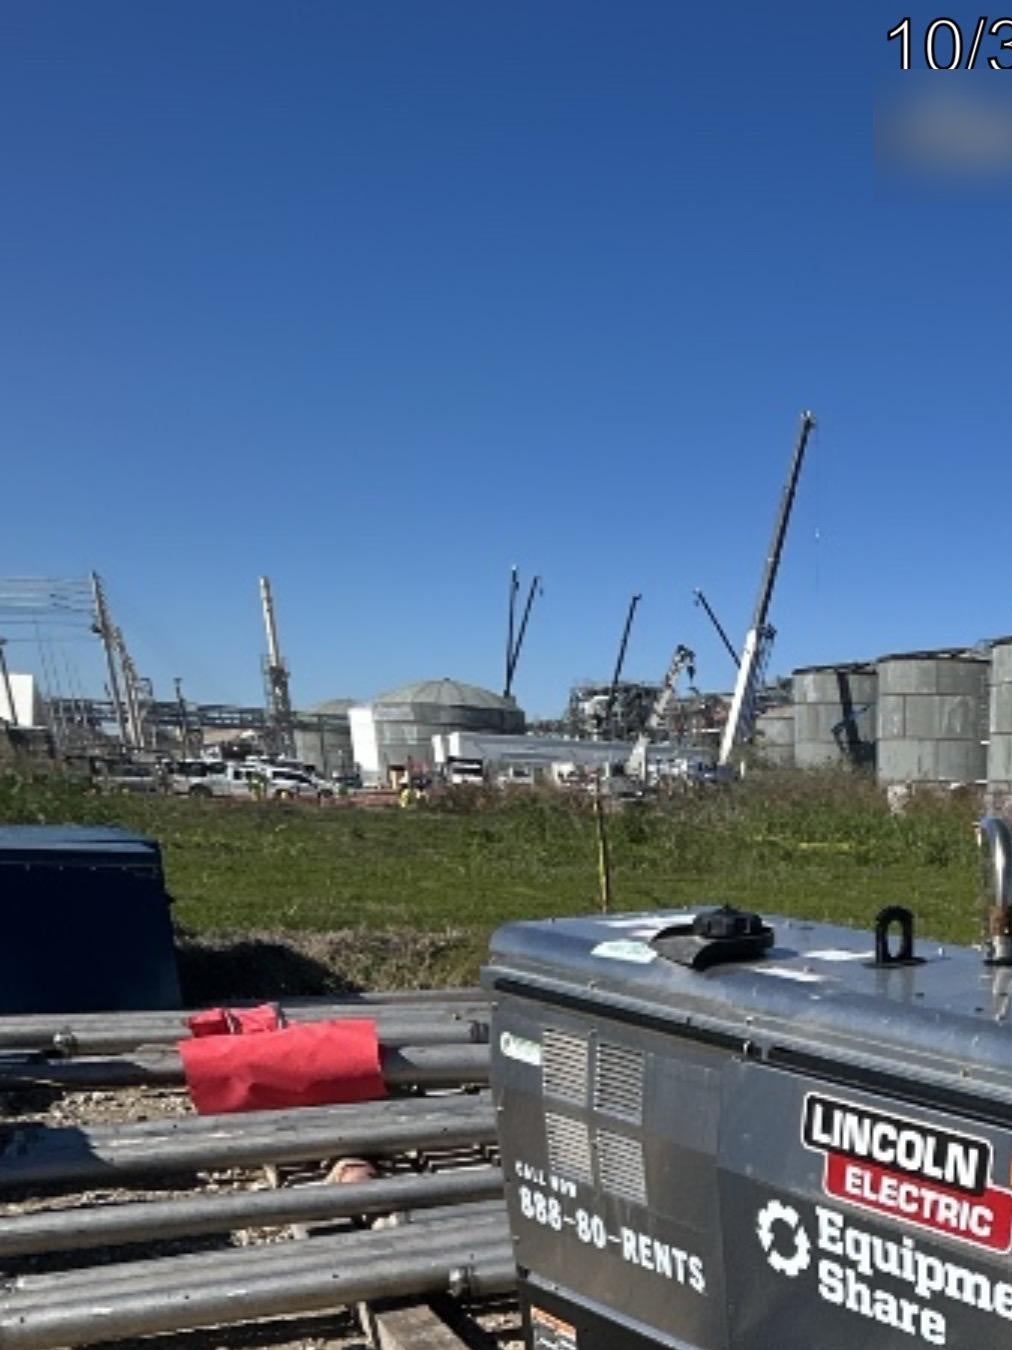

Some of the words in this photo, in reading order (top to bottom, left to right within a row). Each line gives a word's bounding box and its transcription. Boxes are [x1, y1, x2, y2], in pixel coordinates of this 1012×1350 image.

[811, 1102, 980, 1190] LINCOLN
[518, 1185, 706, 1293] 888-80-RENTS
[844, 1165, 995, 1238] ELECTRIC
[817, 1260, 947, 1346] Share
